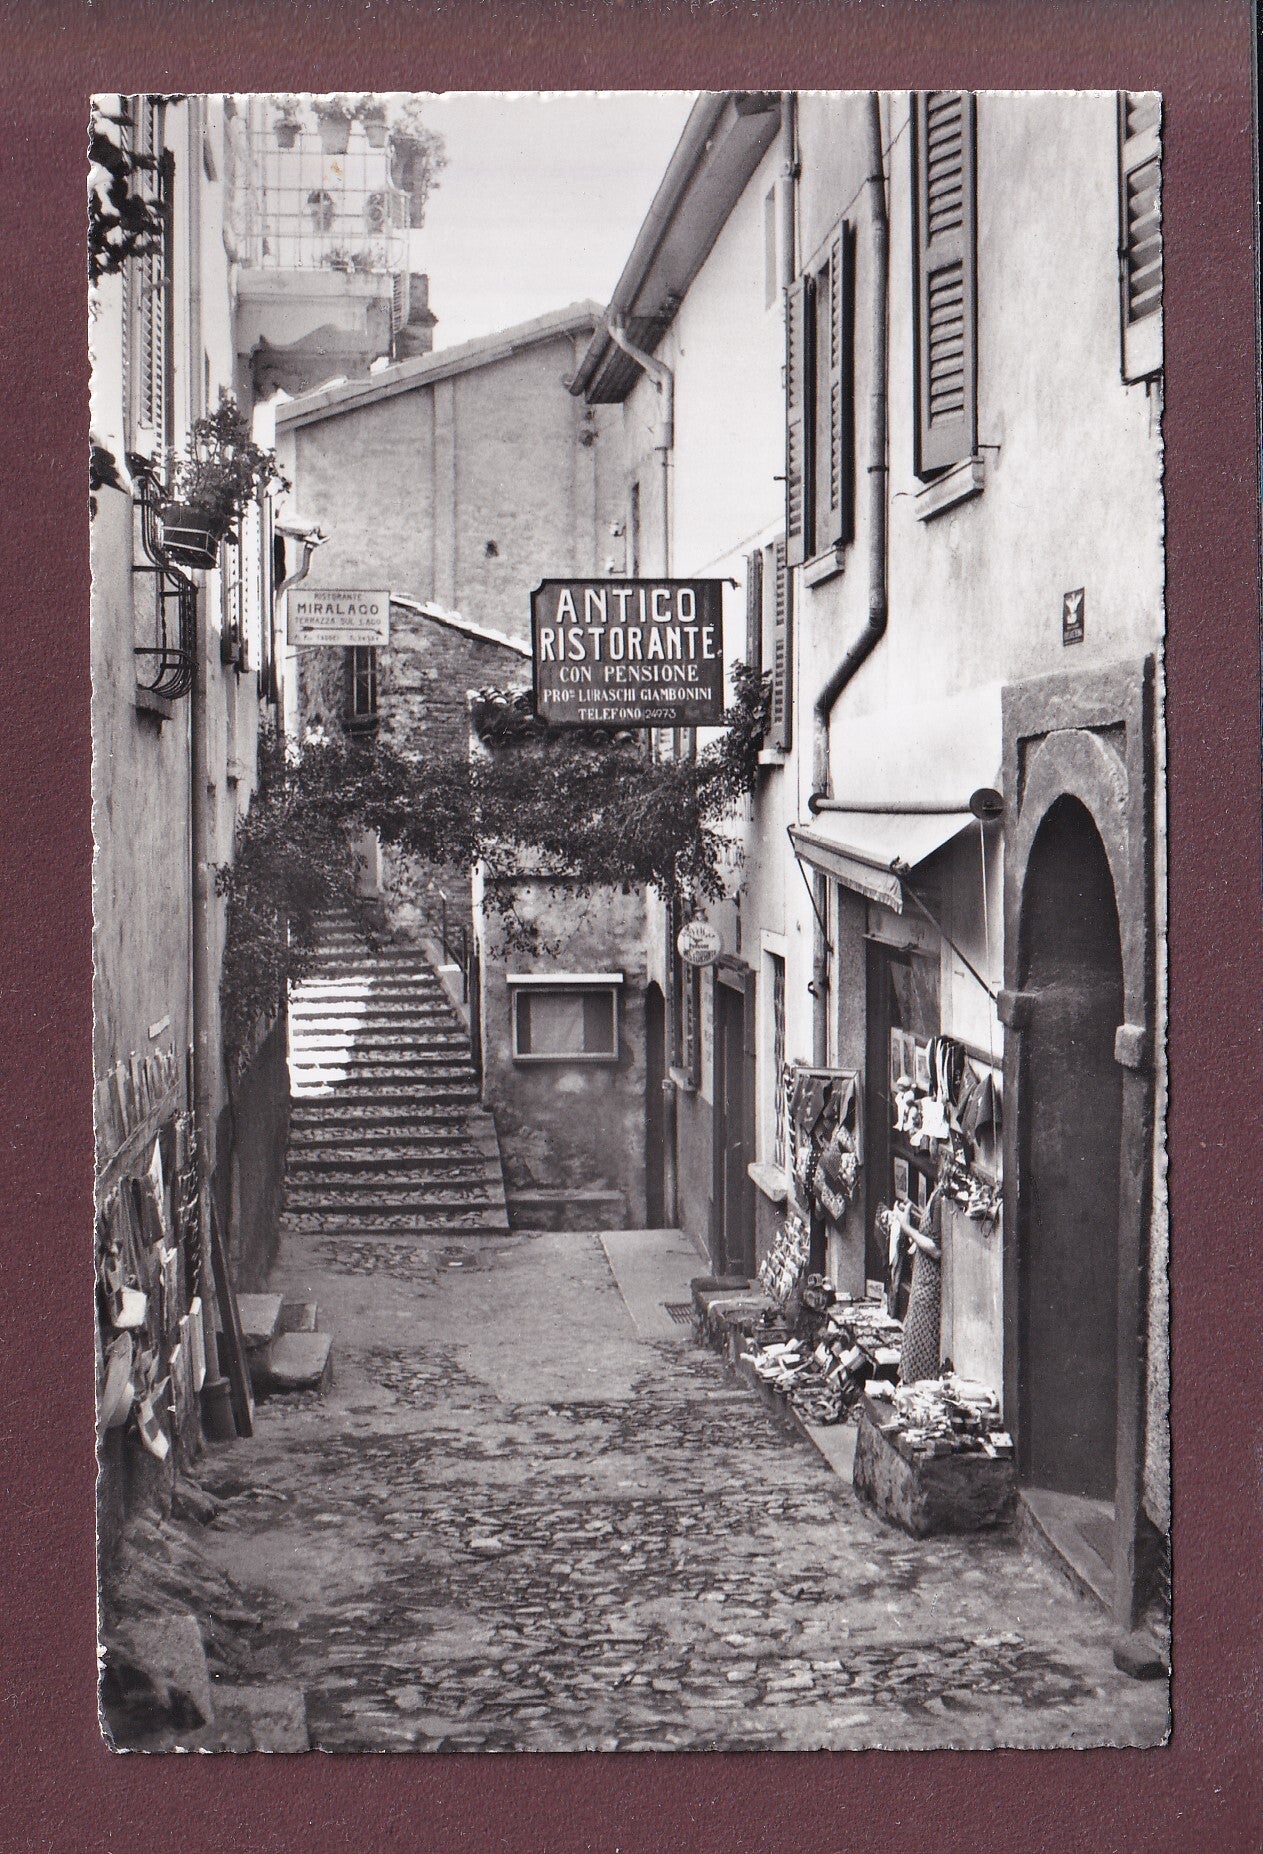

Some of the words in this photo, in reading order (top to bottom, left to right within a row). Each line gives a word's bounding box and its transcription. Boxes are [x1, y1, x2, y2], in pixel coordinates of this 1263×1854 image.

[556, 588, 697, 624] ANTICO
[540, 626, 716, 662] RISTORANTE
[559, 666, 593, 683] CON
[604, 664, 700, 682] PENSIONE
[578, 688, 636, 702] LURASCHI
[640, 687, 712, 701] GIAMBONINI
[578, 707, 642, 721] TELEFONO
